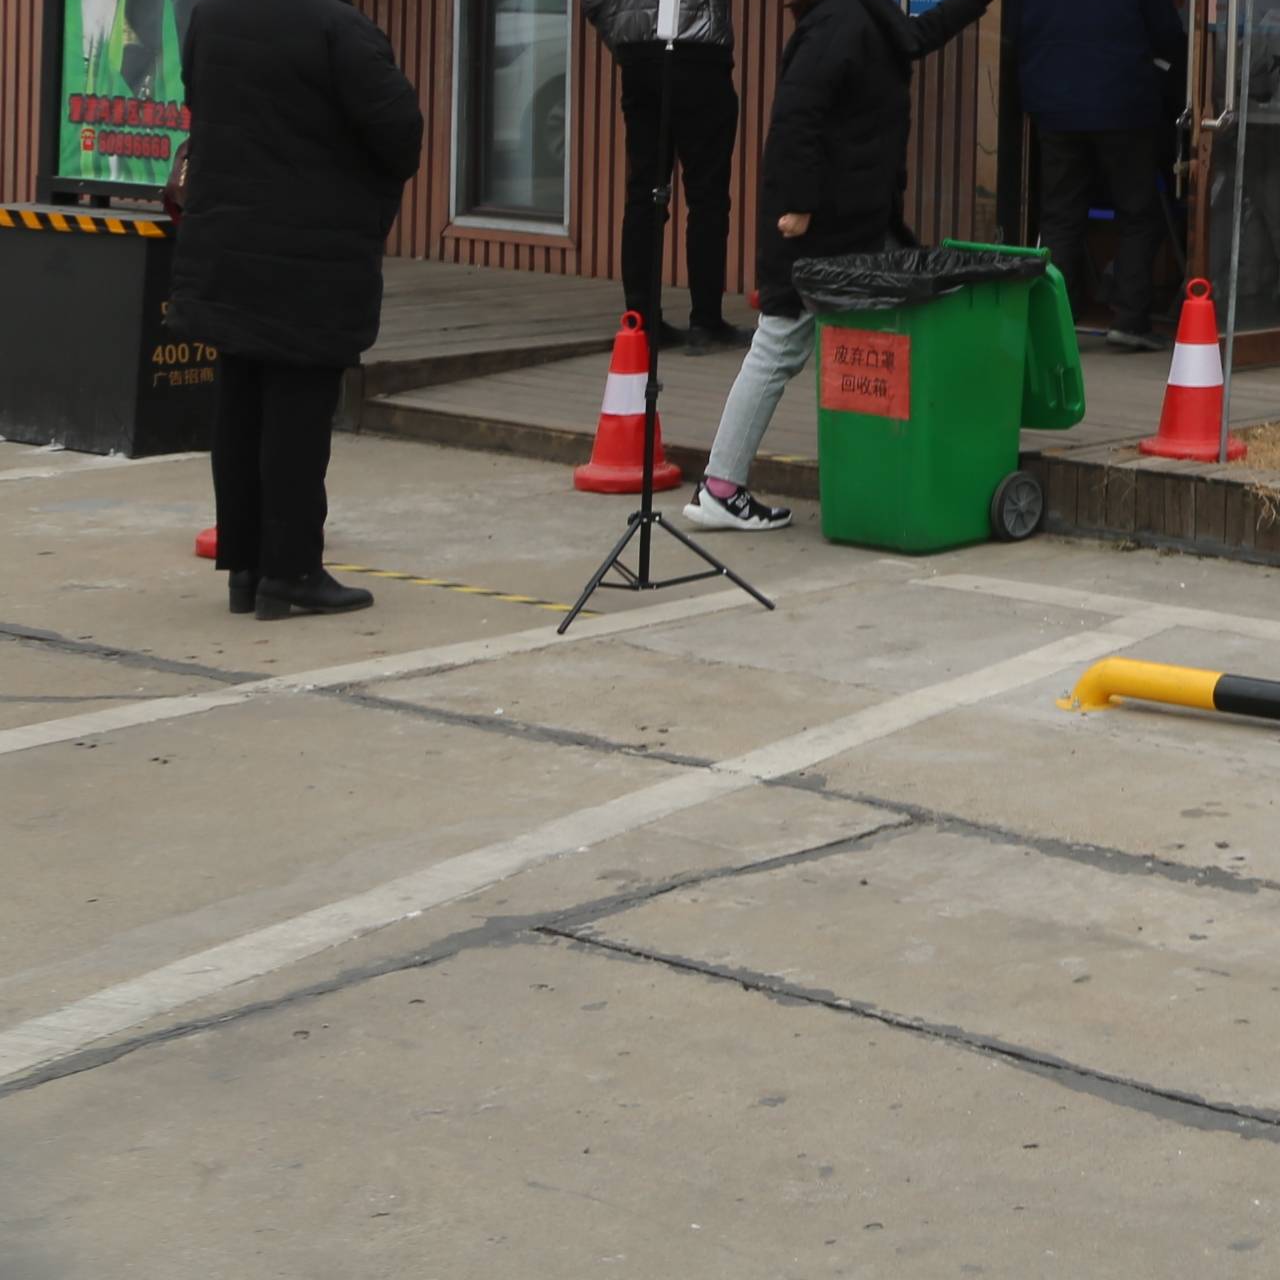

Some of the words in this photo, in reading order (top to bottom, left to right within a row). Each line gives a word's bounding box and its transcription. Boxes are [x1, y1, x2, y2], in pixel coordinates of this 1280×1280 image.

[152, 343, 189, 365] 400
[834, 344, 895, 372] 废弃口罩
[841, 373, 888, 398] 回收箱
